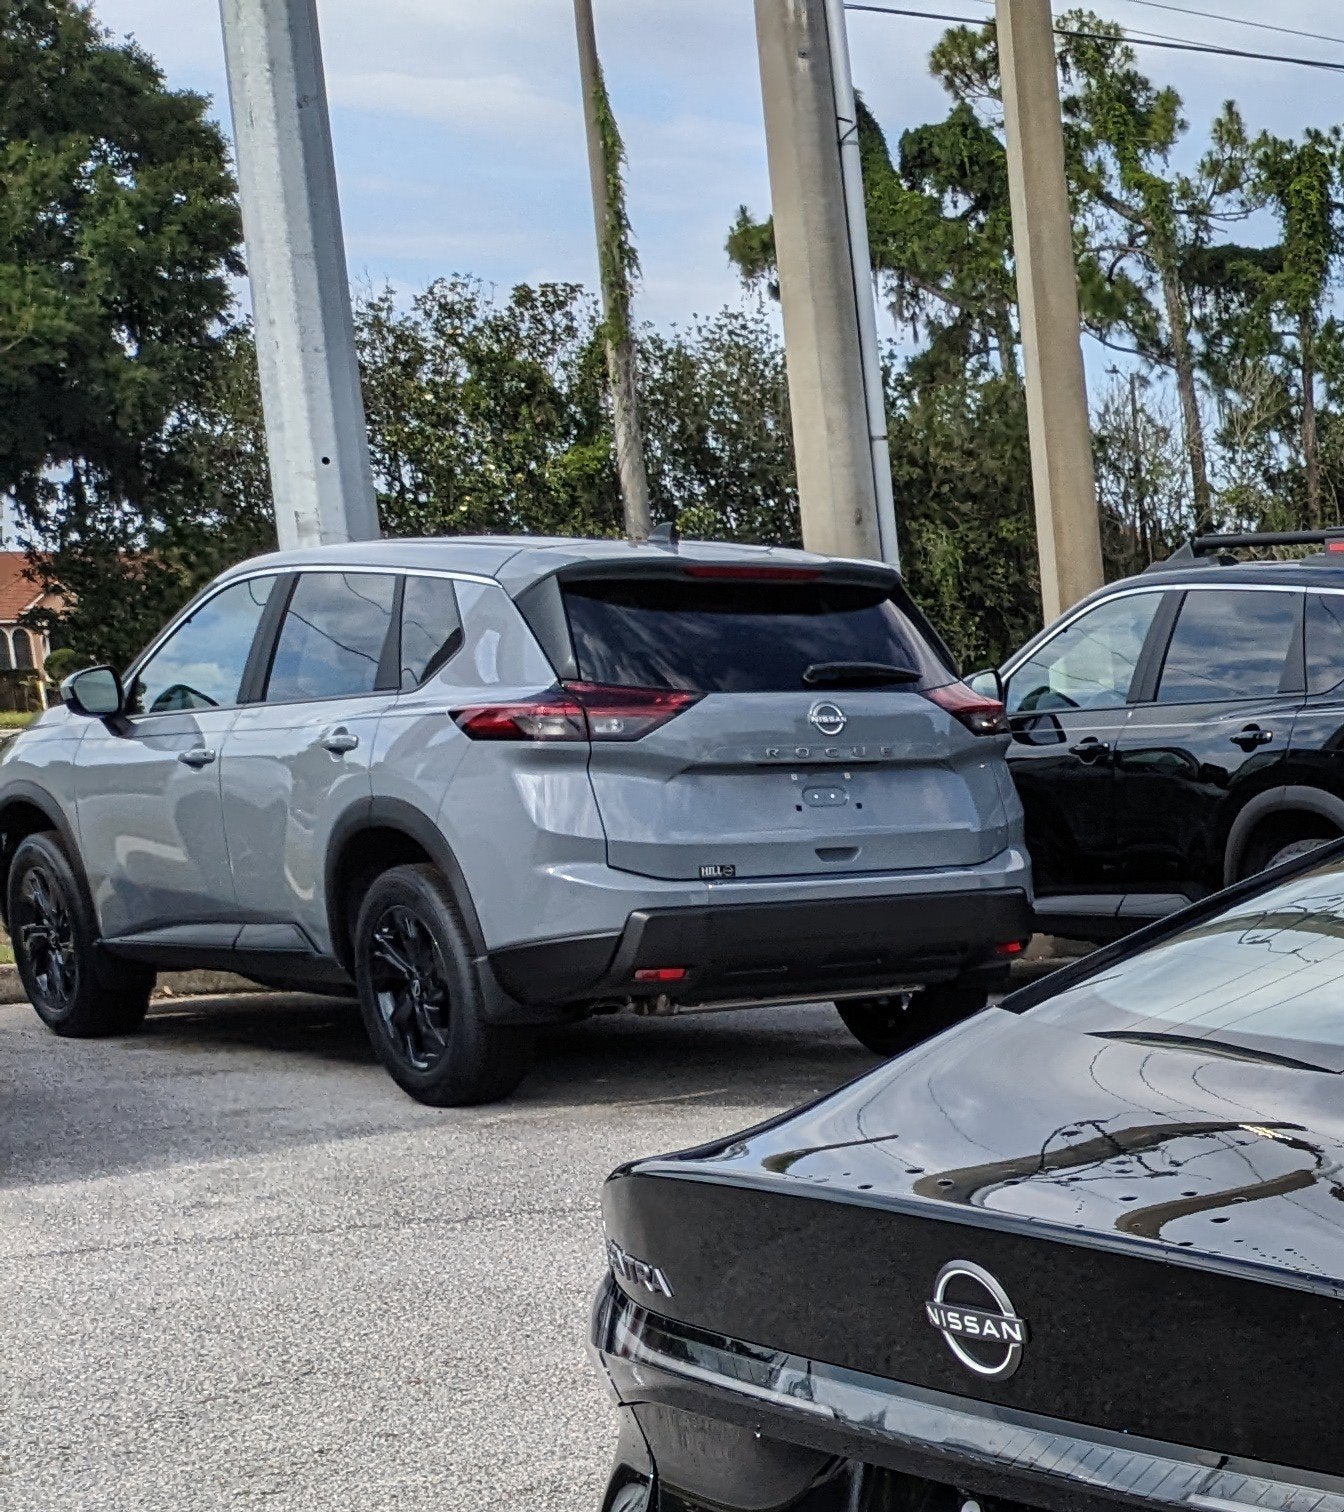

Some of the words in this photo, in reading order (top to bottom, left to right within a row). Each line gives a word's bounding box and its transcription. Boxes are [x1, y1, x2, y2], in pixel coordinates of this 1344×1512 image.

[811, 715, 848, 723] NISSAN
[765, 745, 893, 759] ROGUE
[701, 866, 722, 878] HILL
[926, 1303, 1023, 1341] NISSAN
